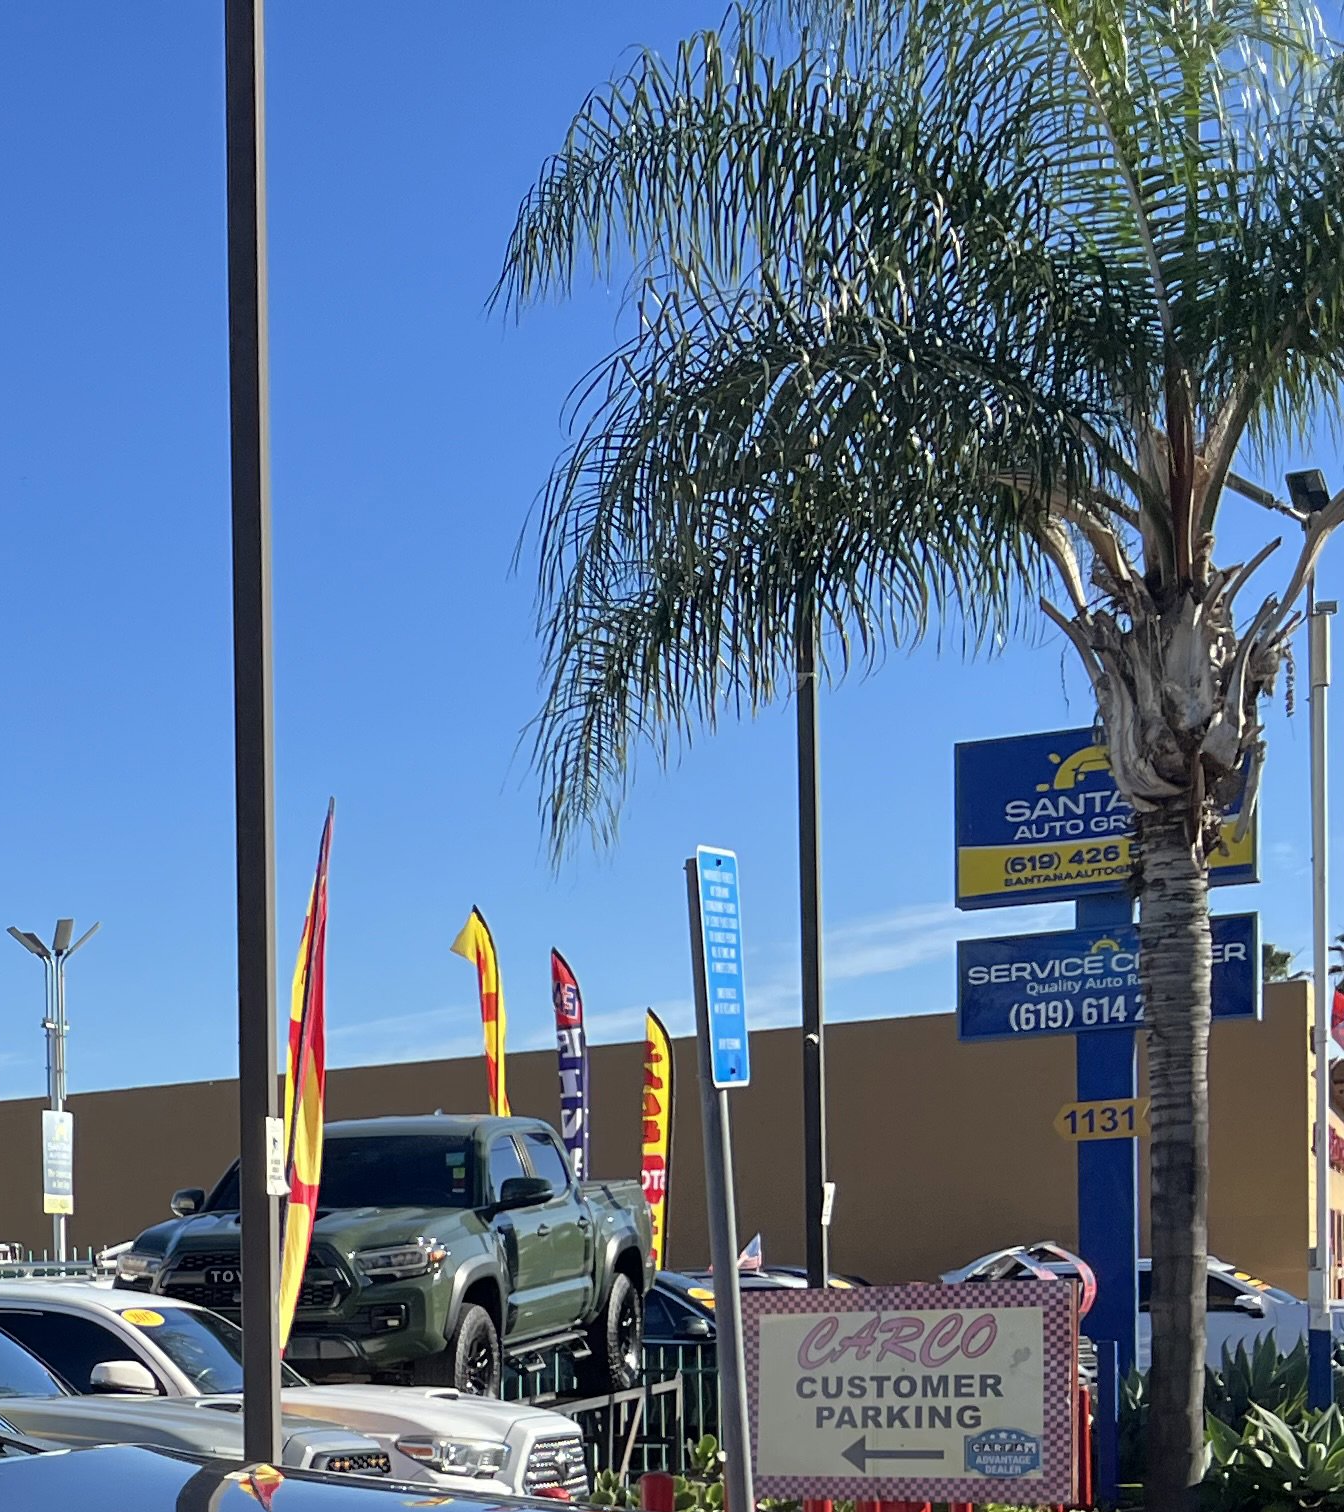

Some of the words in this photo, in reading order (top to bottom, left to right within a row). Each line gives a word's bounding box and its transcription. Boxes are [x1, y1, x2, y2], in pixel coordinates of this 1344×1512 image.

[1014, 819, 1085, 841] AUTO
[1004, 851, 1062, 876] (619)
[1068, 844, 1120, 866] 426
[967, 955, 1105, 986] SERVICE
[1026, 978, 1081, 996] Quality
[1085, 976, 1123, 991] Auto
[1128, 975, 1143, 987] R
[1009, 998, 1074, 1032] (619)
[1082, 995, 1129, 1026] 614
[1064, 1104, 1134, 1135] 1131
[798, 1312, 999, 1369] CARCO
[795, 1372, 1004, 1400] CUSTOMER
[815, 1404, 983, 1430] PARKING
[972, 1442, 1037, 1454] CARFAX
[975, 1455, 1031, 1465] ADVANTAGE
[985, 1465, 1022, 1475] DEALER
